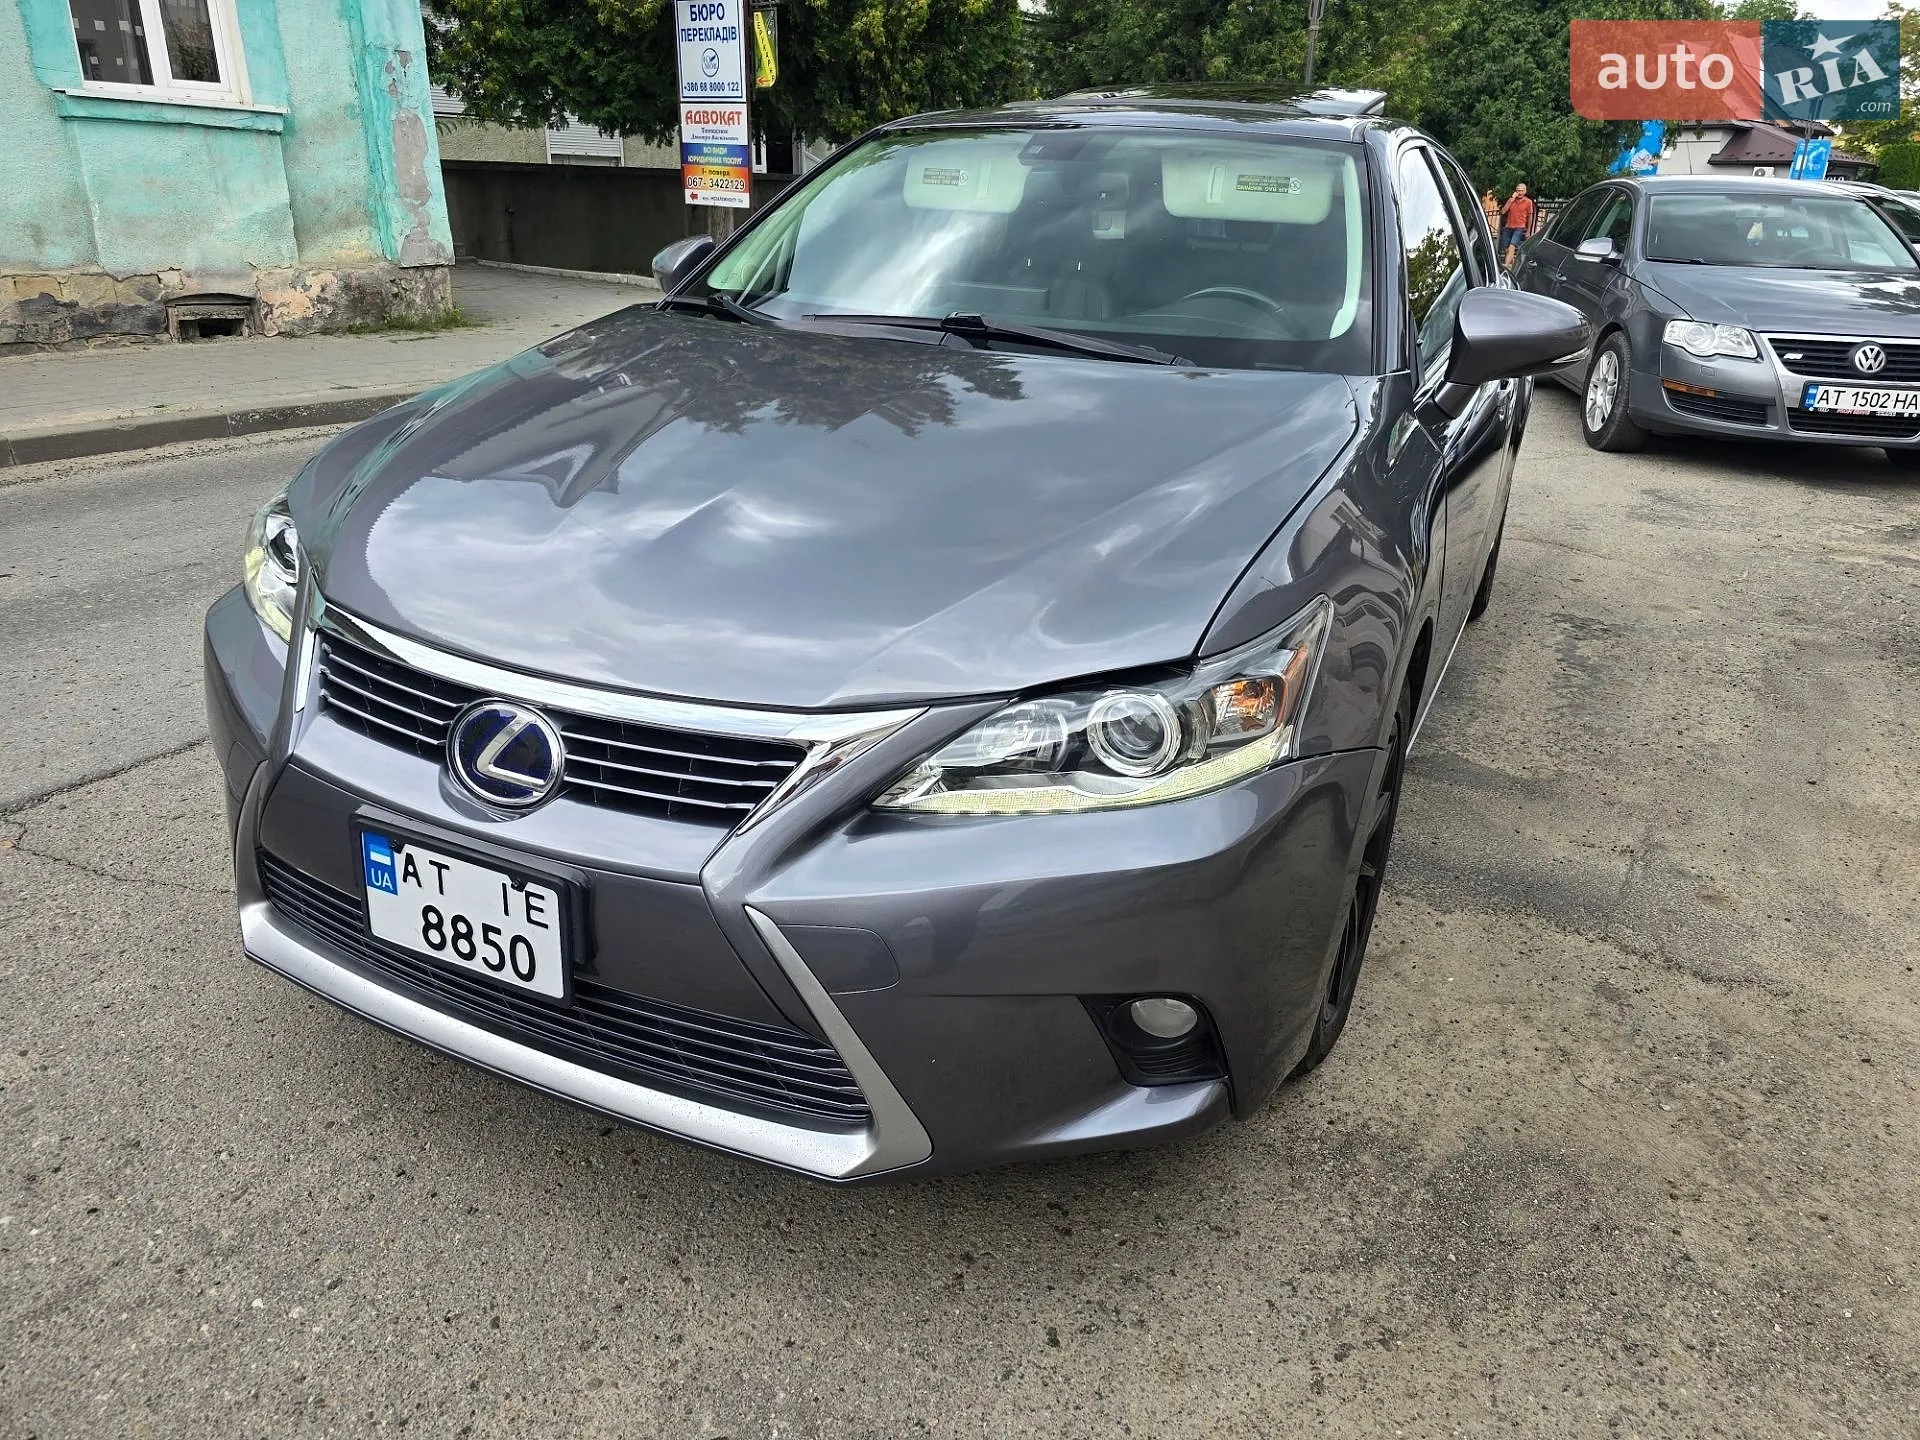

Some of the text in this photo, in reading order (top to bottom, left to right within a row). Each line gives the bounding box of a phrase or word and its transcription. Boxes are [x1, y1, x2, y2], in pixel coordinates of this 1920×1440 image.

[689, 3, 725, 22] БЮРО
[680, 26, 737, 43] ПЕРЕКЛАДІВ
[684, 82, 698, 92] +380
[727, 82, 739, 92] 122
[685, 110, 742, 127] АДВОКАТ
[1817, 389, 1918, 410] AT 1502 HA
[370, 868, 394, 891] UA
[402, 853, 450, 895] AT
[421, 904, 536, 983] 8850
